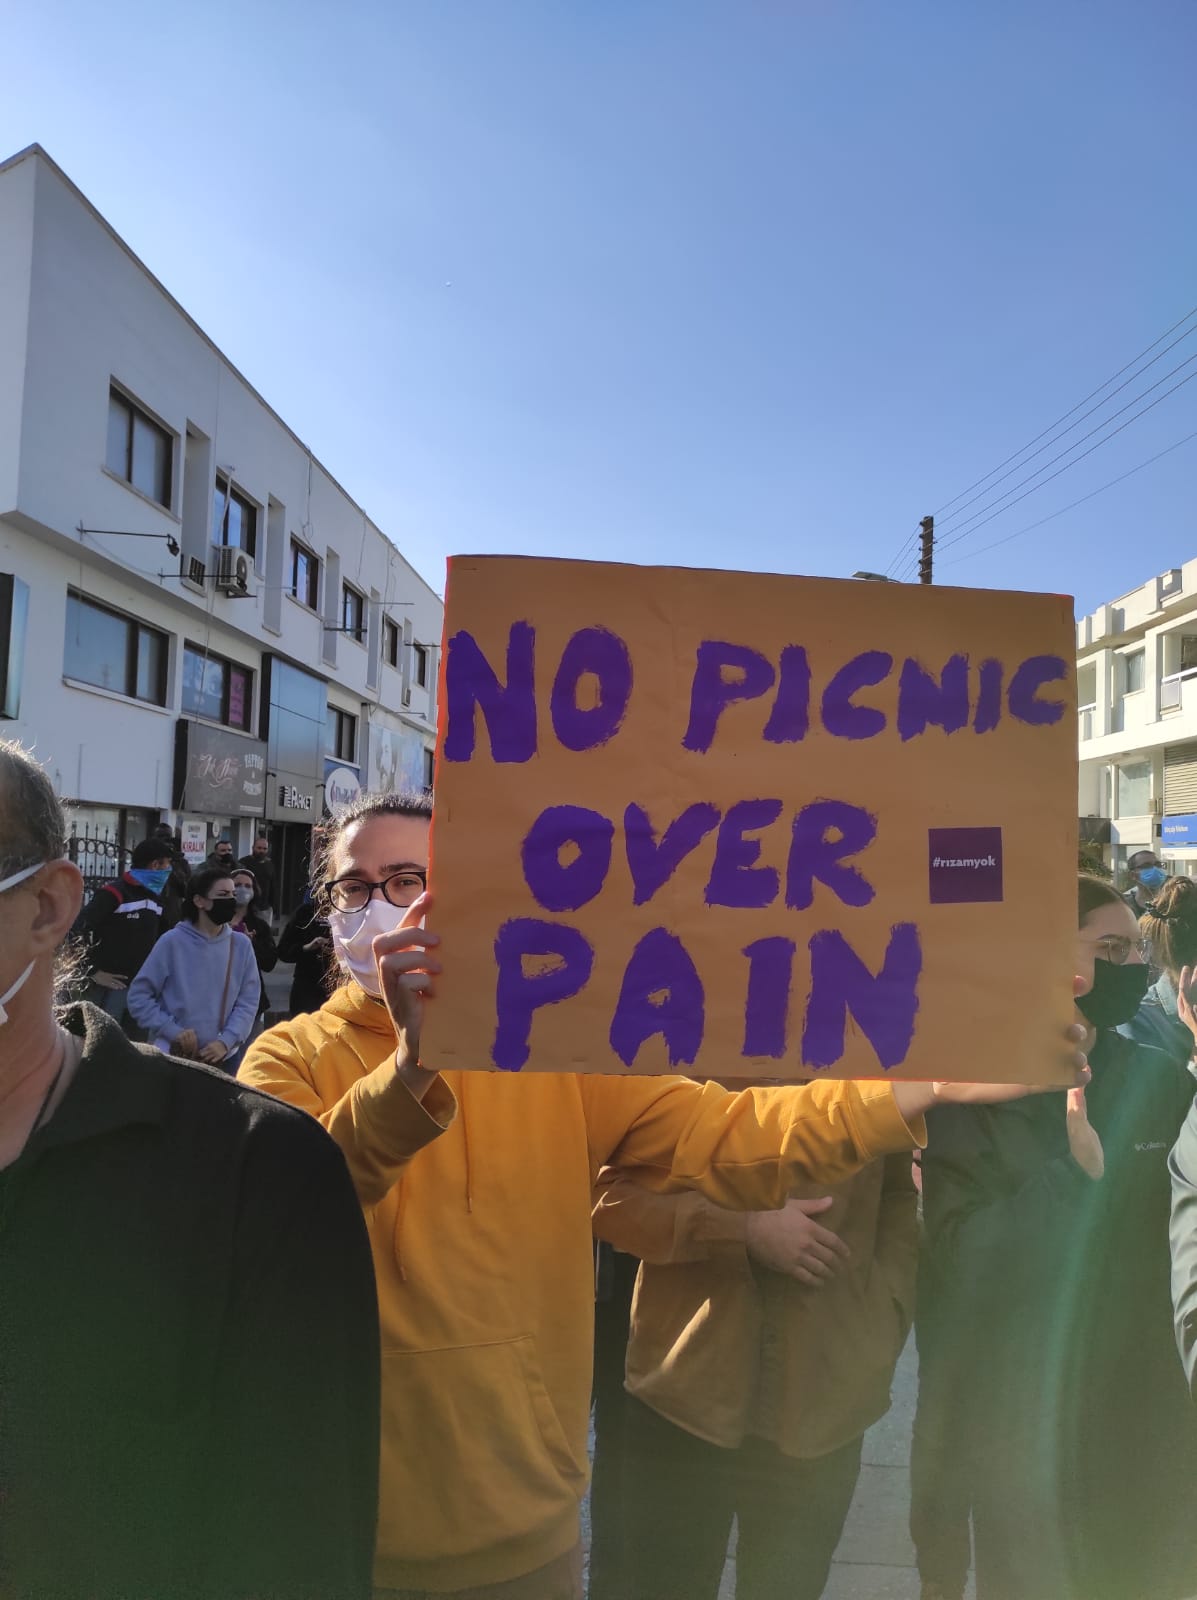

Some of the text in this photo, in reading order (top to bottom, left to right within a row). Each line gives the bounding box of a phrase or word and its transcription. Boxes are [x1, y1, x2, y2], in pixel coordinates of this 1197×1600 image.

[444, 620, 1068, 763] NO PICNIC
[521, 798, 878, 912] OVER
[491, 916, 924, 1072] PAIN
